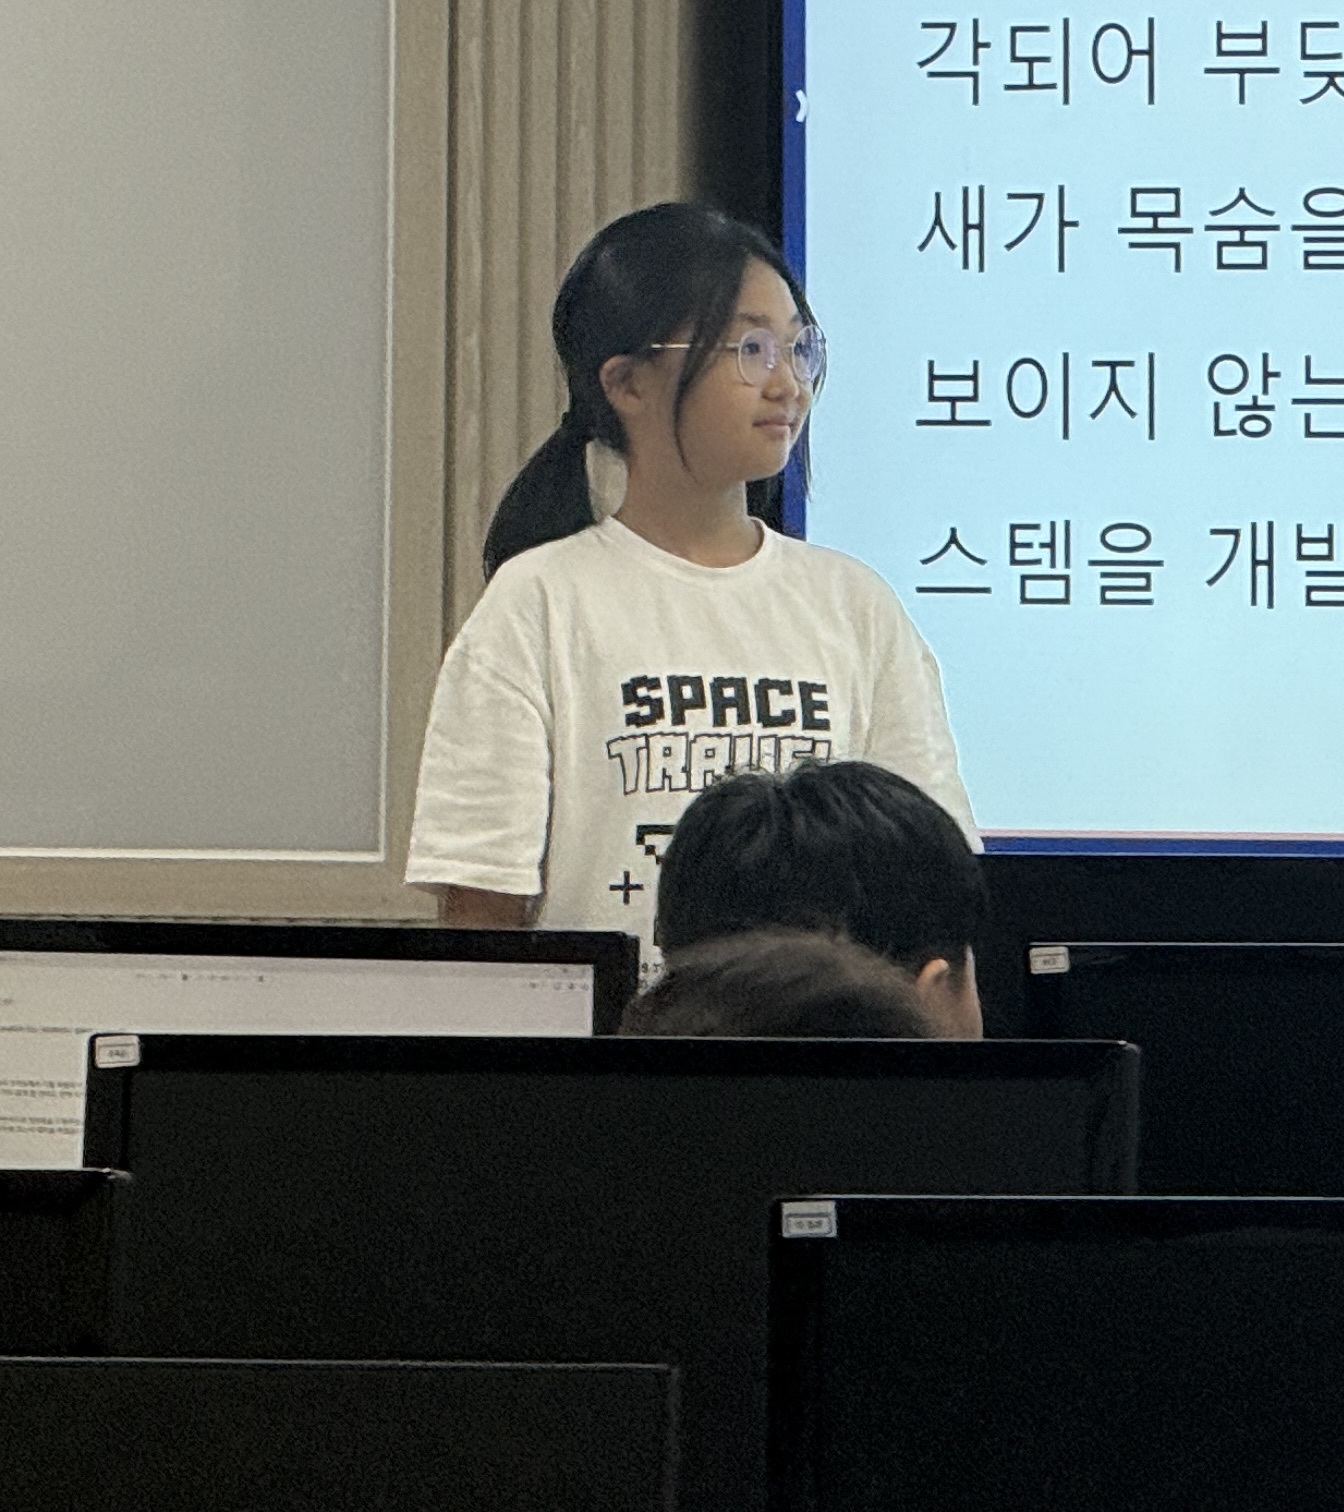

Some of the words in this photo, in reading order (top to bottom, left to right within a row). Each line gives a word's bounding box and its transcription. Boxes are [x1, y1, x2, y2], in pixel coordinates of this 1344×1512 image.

[917, 17, 1159, 106] 각되어
[918, 184, 1080, 273] 새가
[915, 352, 1158, 441] 보이지
[915, 519, 1165, 606] 스템을
[621, 675, 831, 731] SPACE
